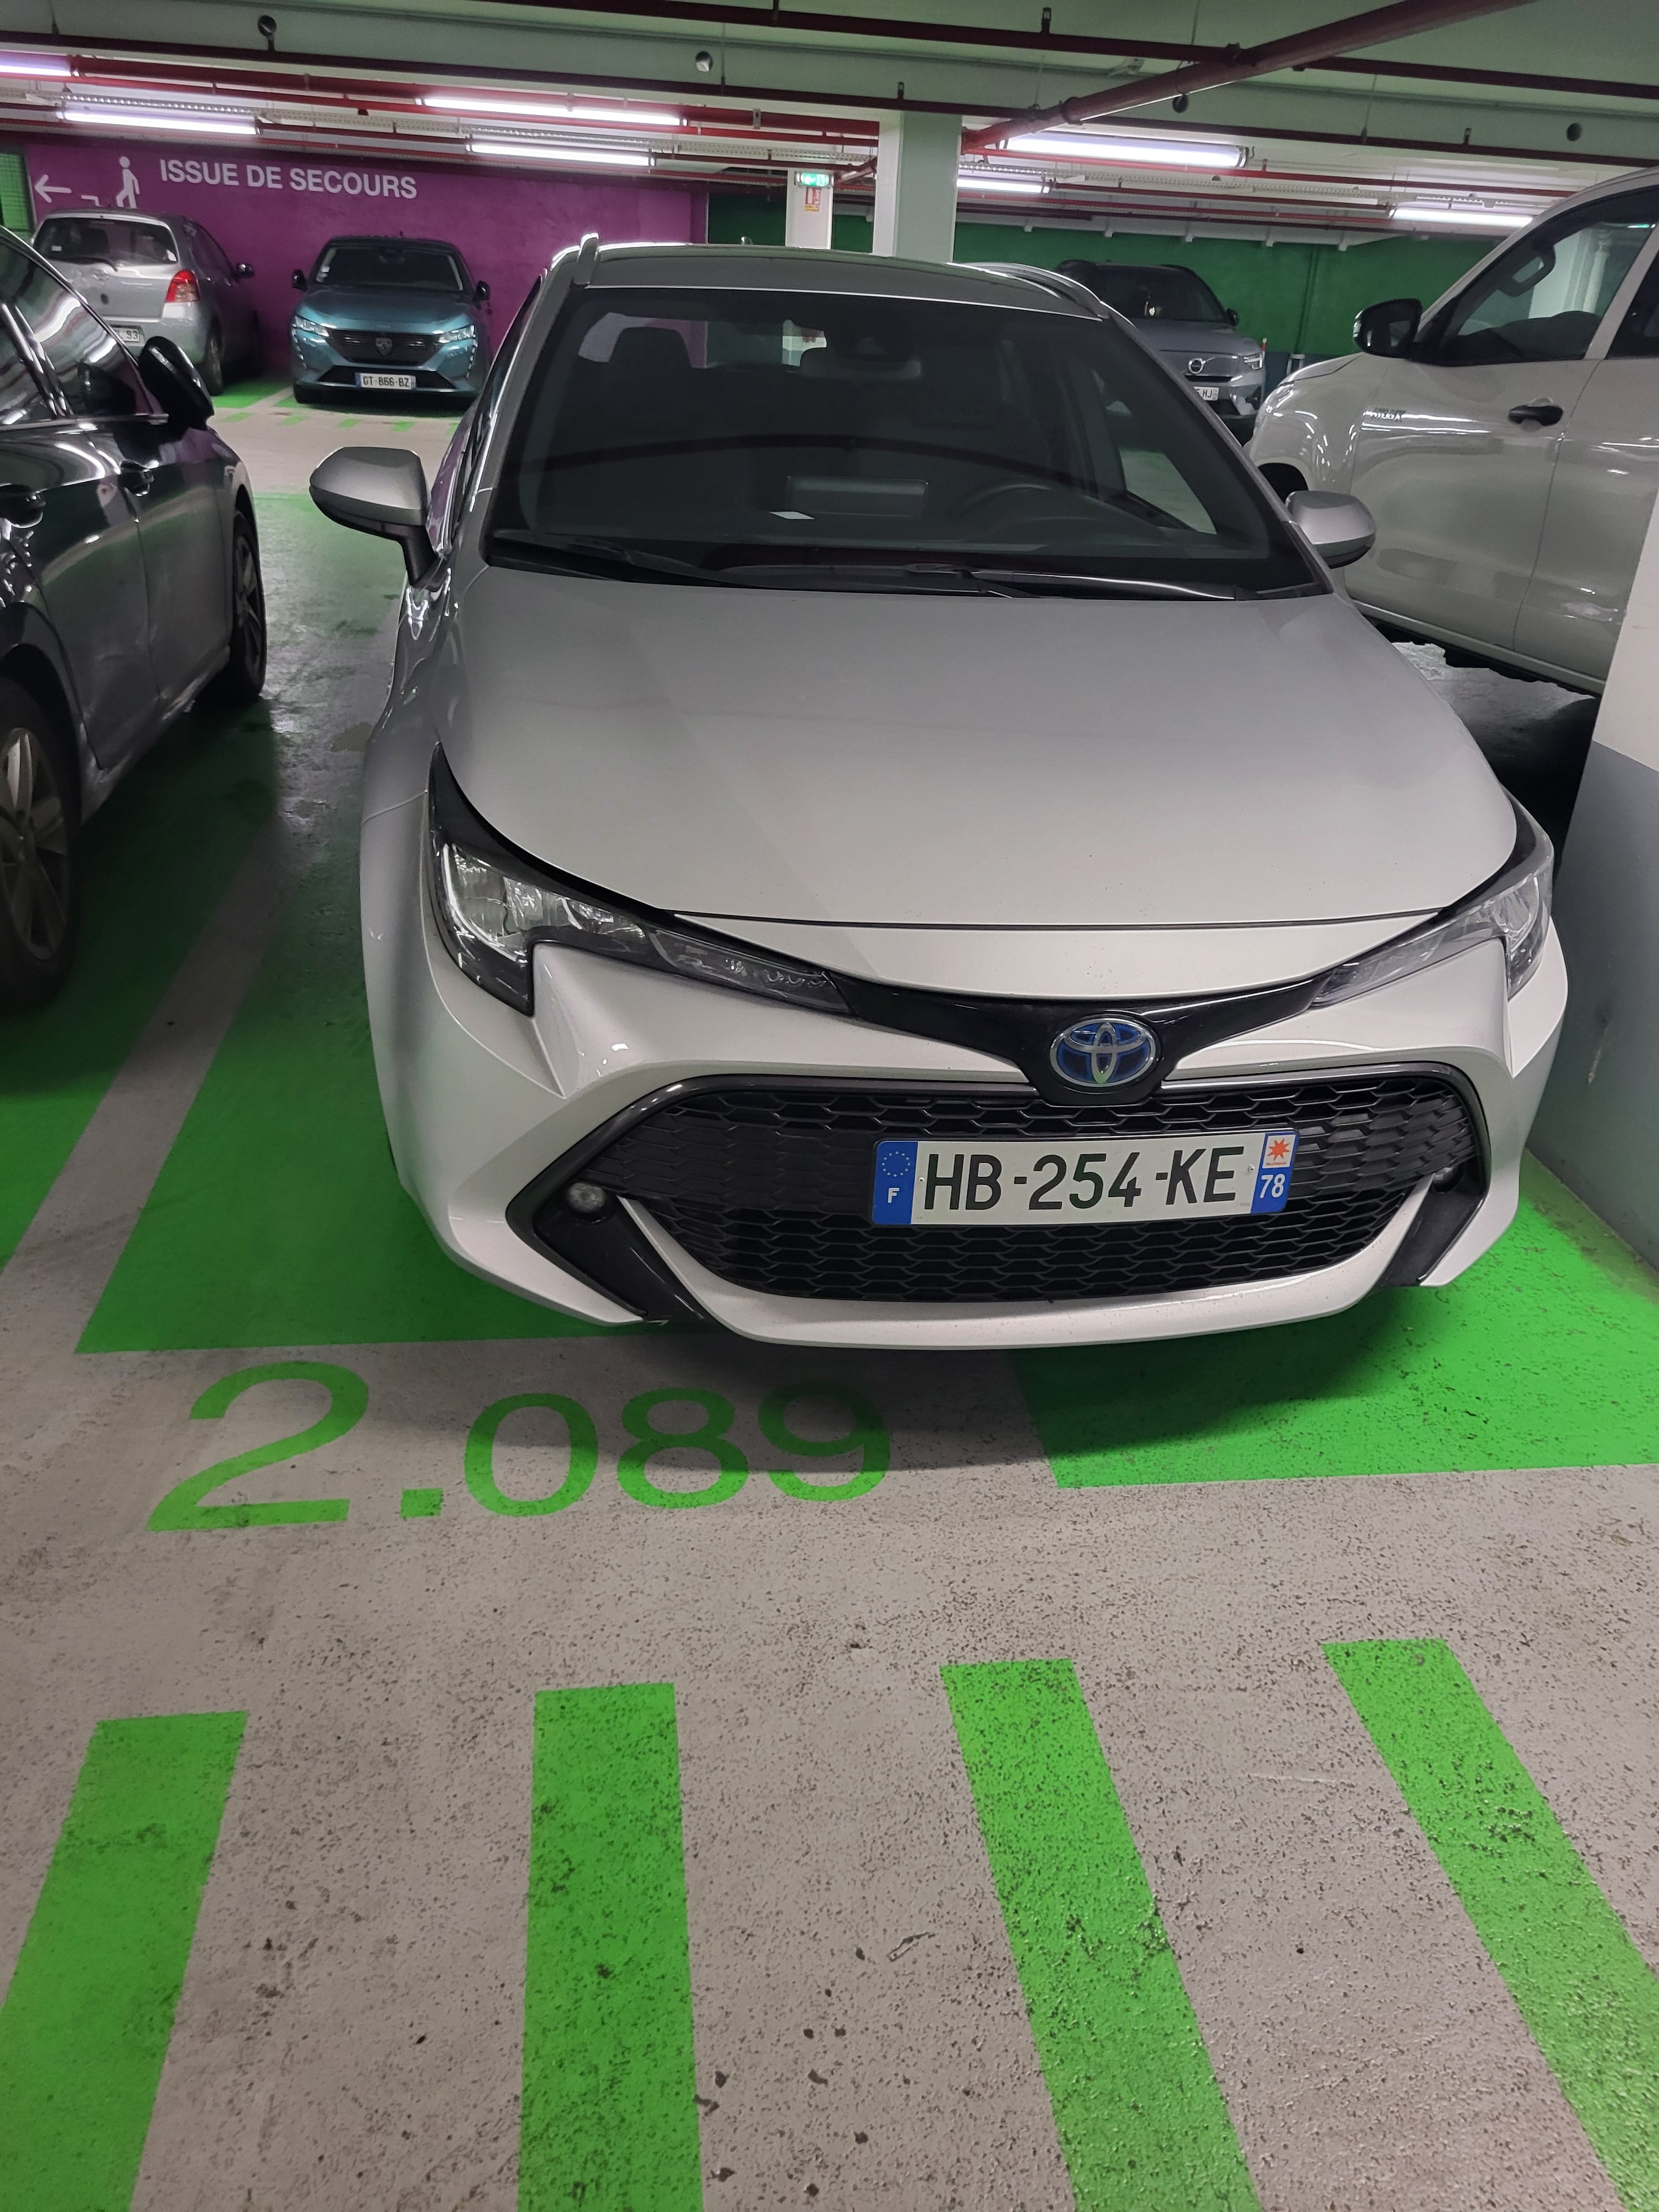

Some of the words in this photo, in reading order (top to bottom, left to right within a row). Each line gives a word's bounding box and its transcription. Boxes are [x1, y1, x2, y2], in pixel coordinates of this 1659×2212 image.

[160, 159, 239, 186] ISSUE
[247, 165, 283, 189] DE
[290, 168, 418, 199] SECOURS
[888, 1187, 900, 1203] F
[924, 1146, 1245, 1211] HB-254-KE
[1260, 1173, 1286, 1199] 78
[147, 1361, 890, 1532] 2.089
